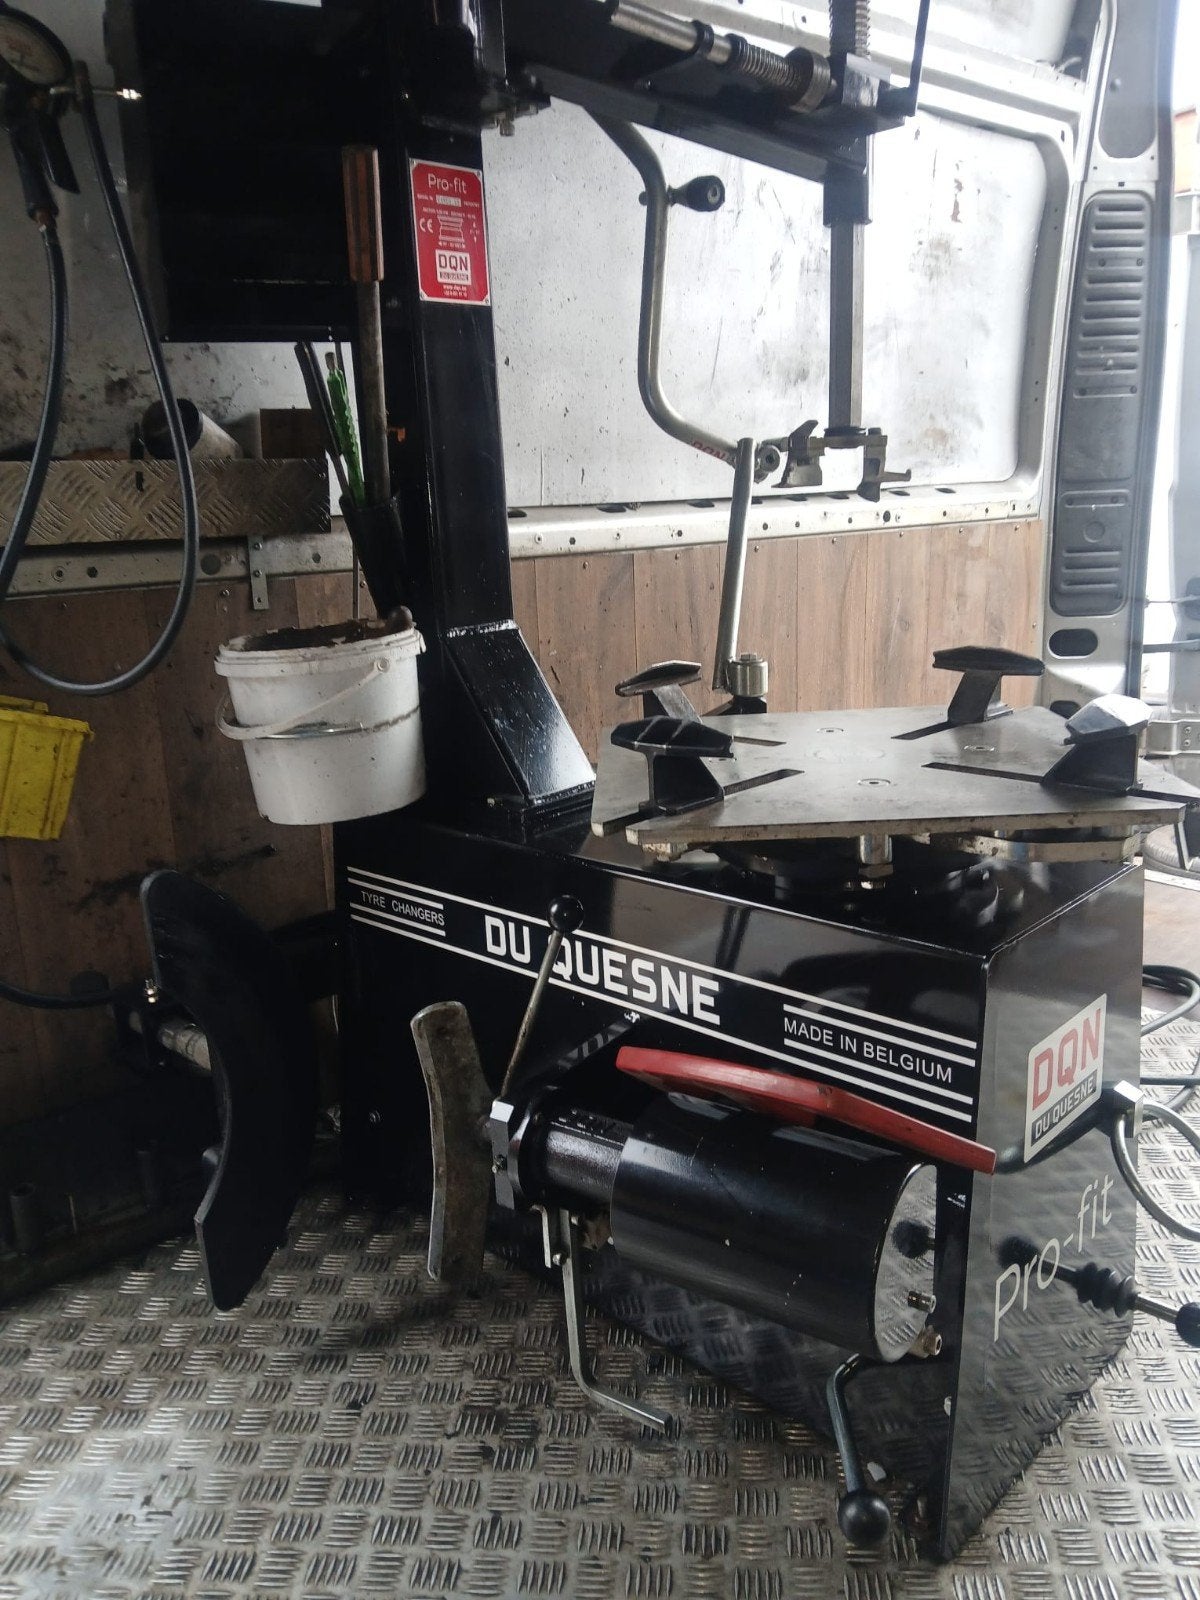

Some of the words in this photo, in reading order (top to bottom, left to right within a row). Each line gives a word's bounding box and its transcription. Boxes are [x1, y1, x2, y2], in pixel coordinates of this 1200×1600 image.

[427, 173, 467, 194] Pro-fit
[419, 217, 434, 234] CE
[438, 254, 468, 271] DQN
[361, 891, 386, 907] TYRE
[391, 900, 445, 926] CHANGERS
[484, 915, 531, 963] DU
[547, 934, 721, 1026] QUESNE
[784, 1017, 834, 1047] MADE
[839, 1034, 858, 1054] IN
[863, 1041, 953, 1084] BELGIUM
[1033, 1008, 1101, 1112] DQN
[1034, 1112, 1051, 1140] DU
[1052, 1078, 1095, 1124] QUESNE
